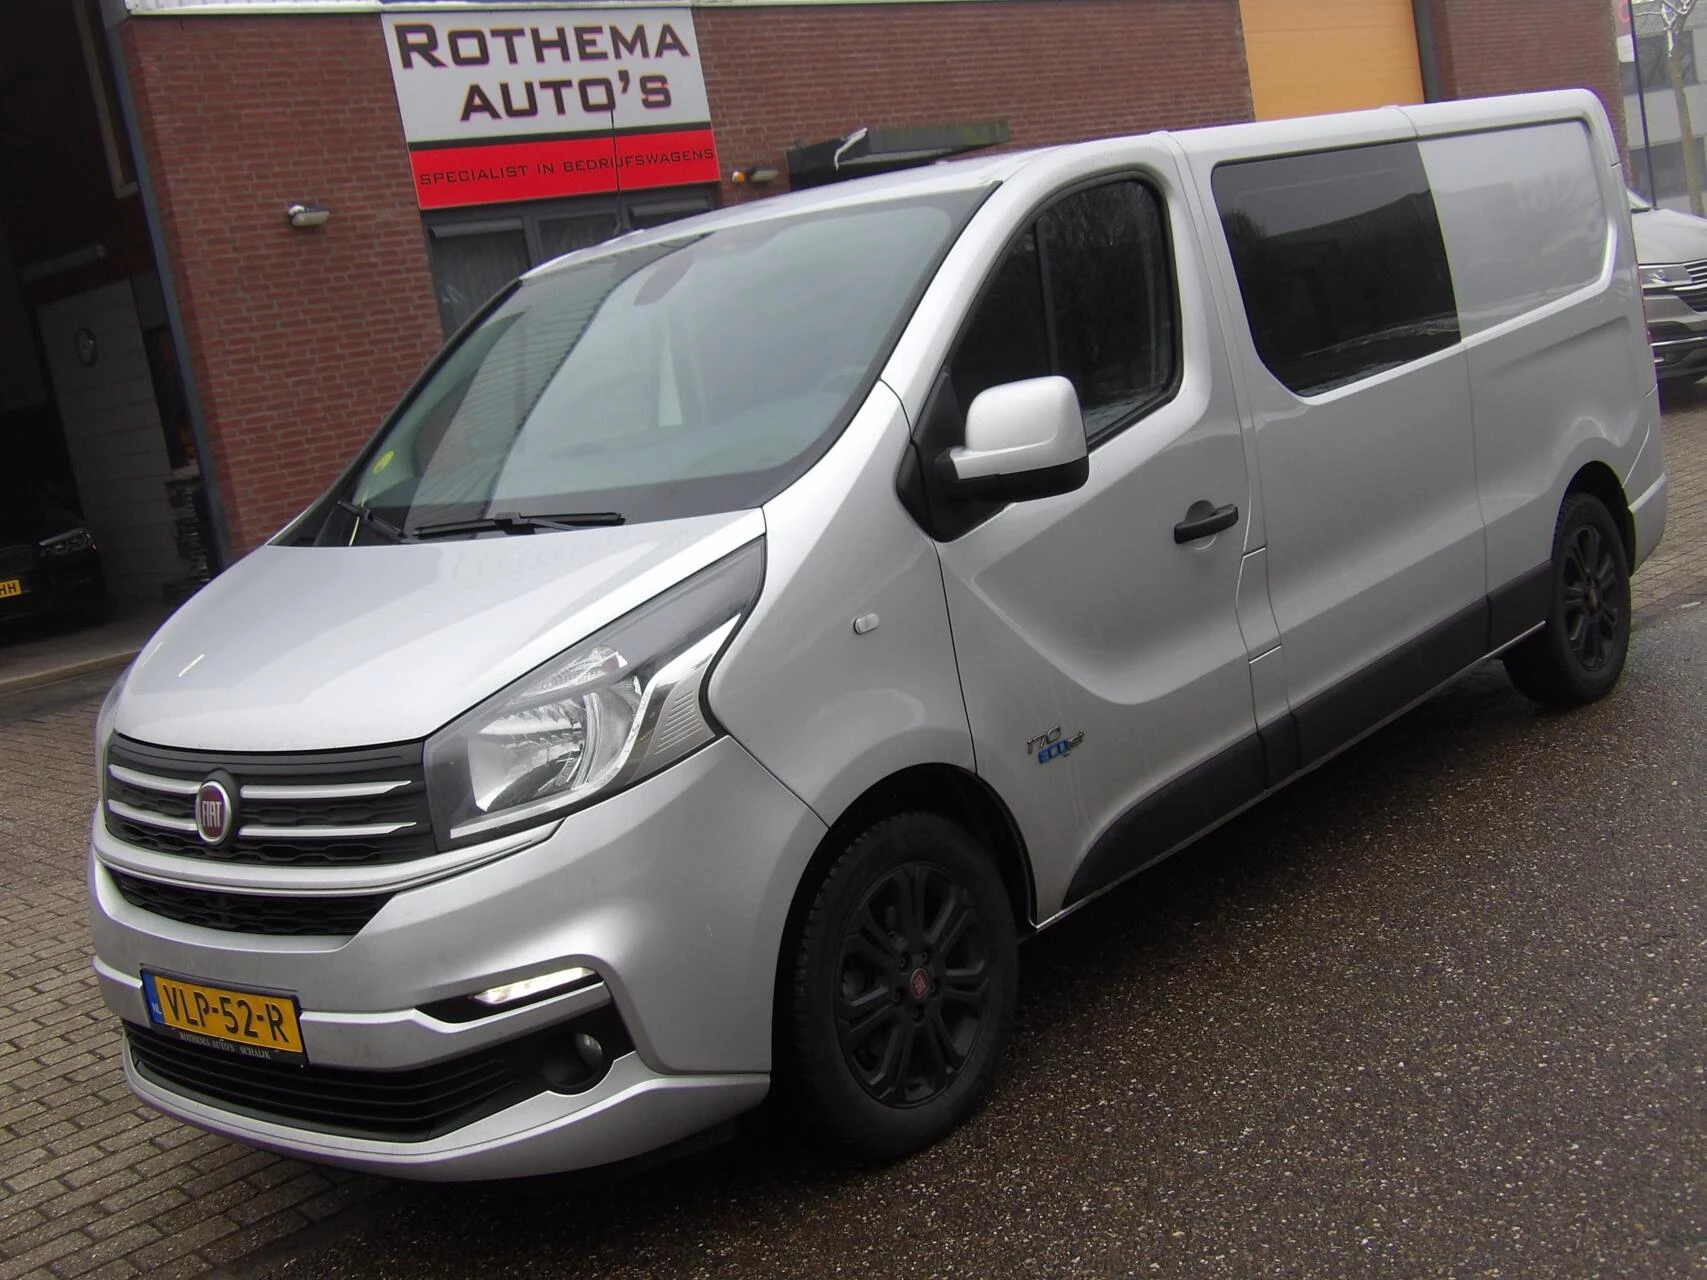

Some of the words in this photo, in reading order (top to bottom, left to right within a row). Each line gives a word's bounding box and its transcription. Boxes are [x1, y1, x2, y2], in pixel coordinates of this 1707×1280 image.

[393, 23, 691, 69] ROTHEMA
[460, 70, 673, 122] AUTO'S
[419, 164, 528, 186] SPECIALIST
[536, 163, 555, 175] IN
[563, 148, 715, 173] BEDRIJFSWAGENS
[201, 800, 222, 828] FIAT
[151, 1001, 163, 1015] NL
[163, 984, 290, 1043] VLP-52-R
